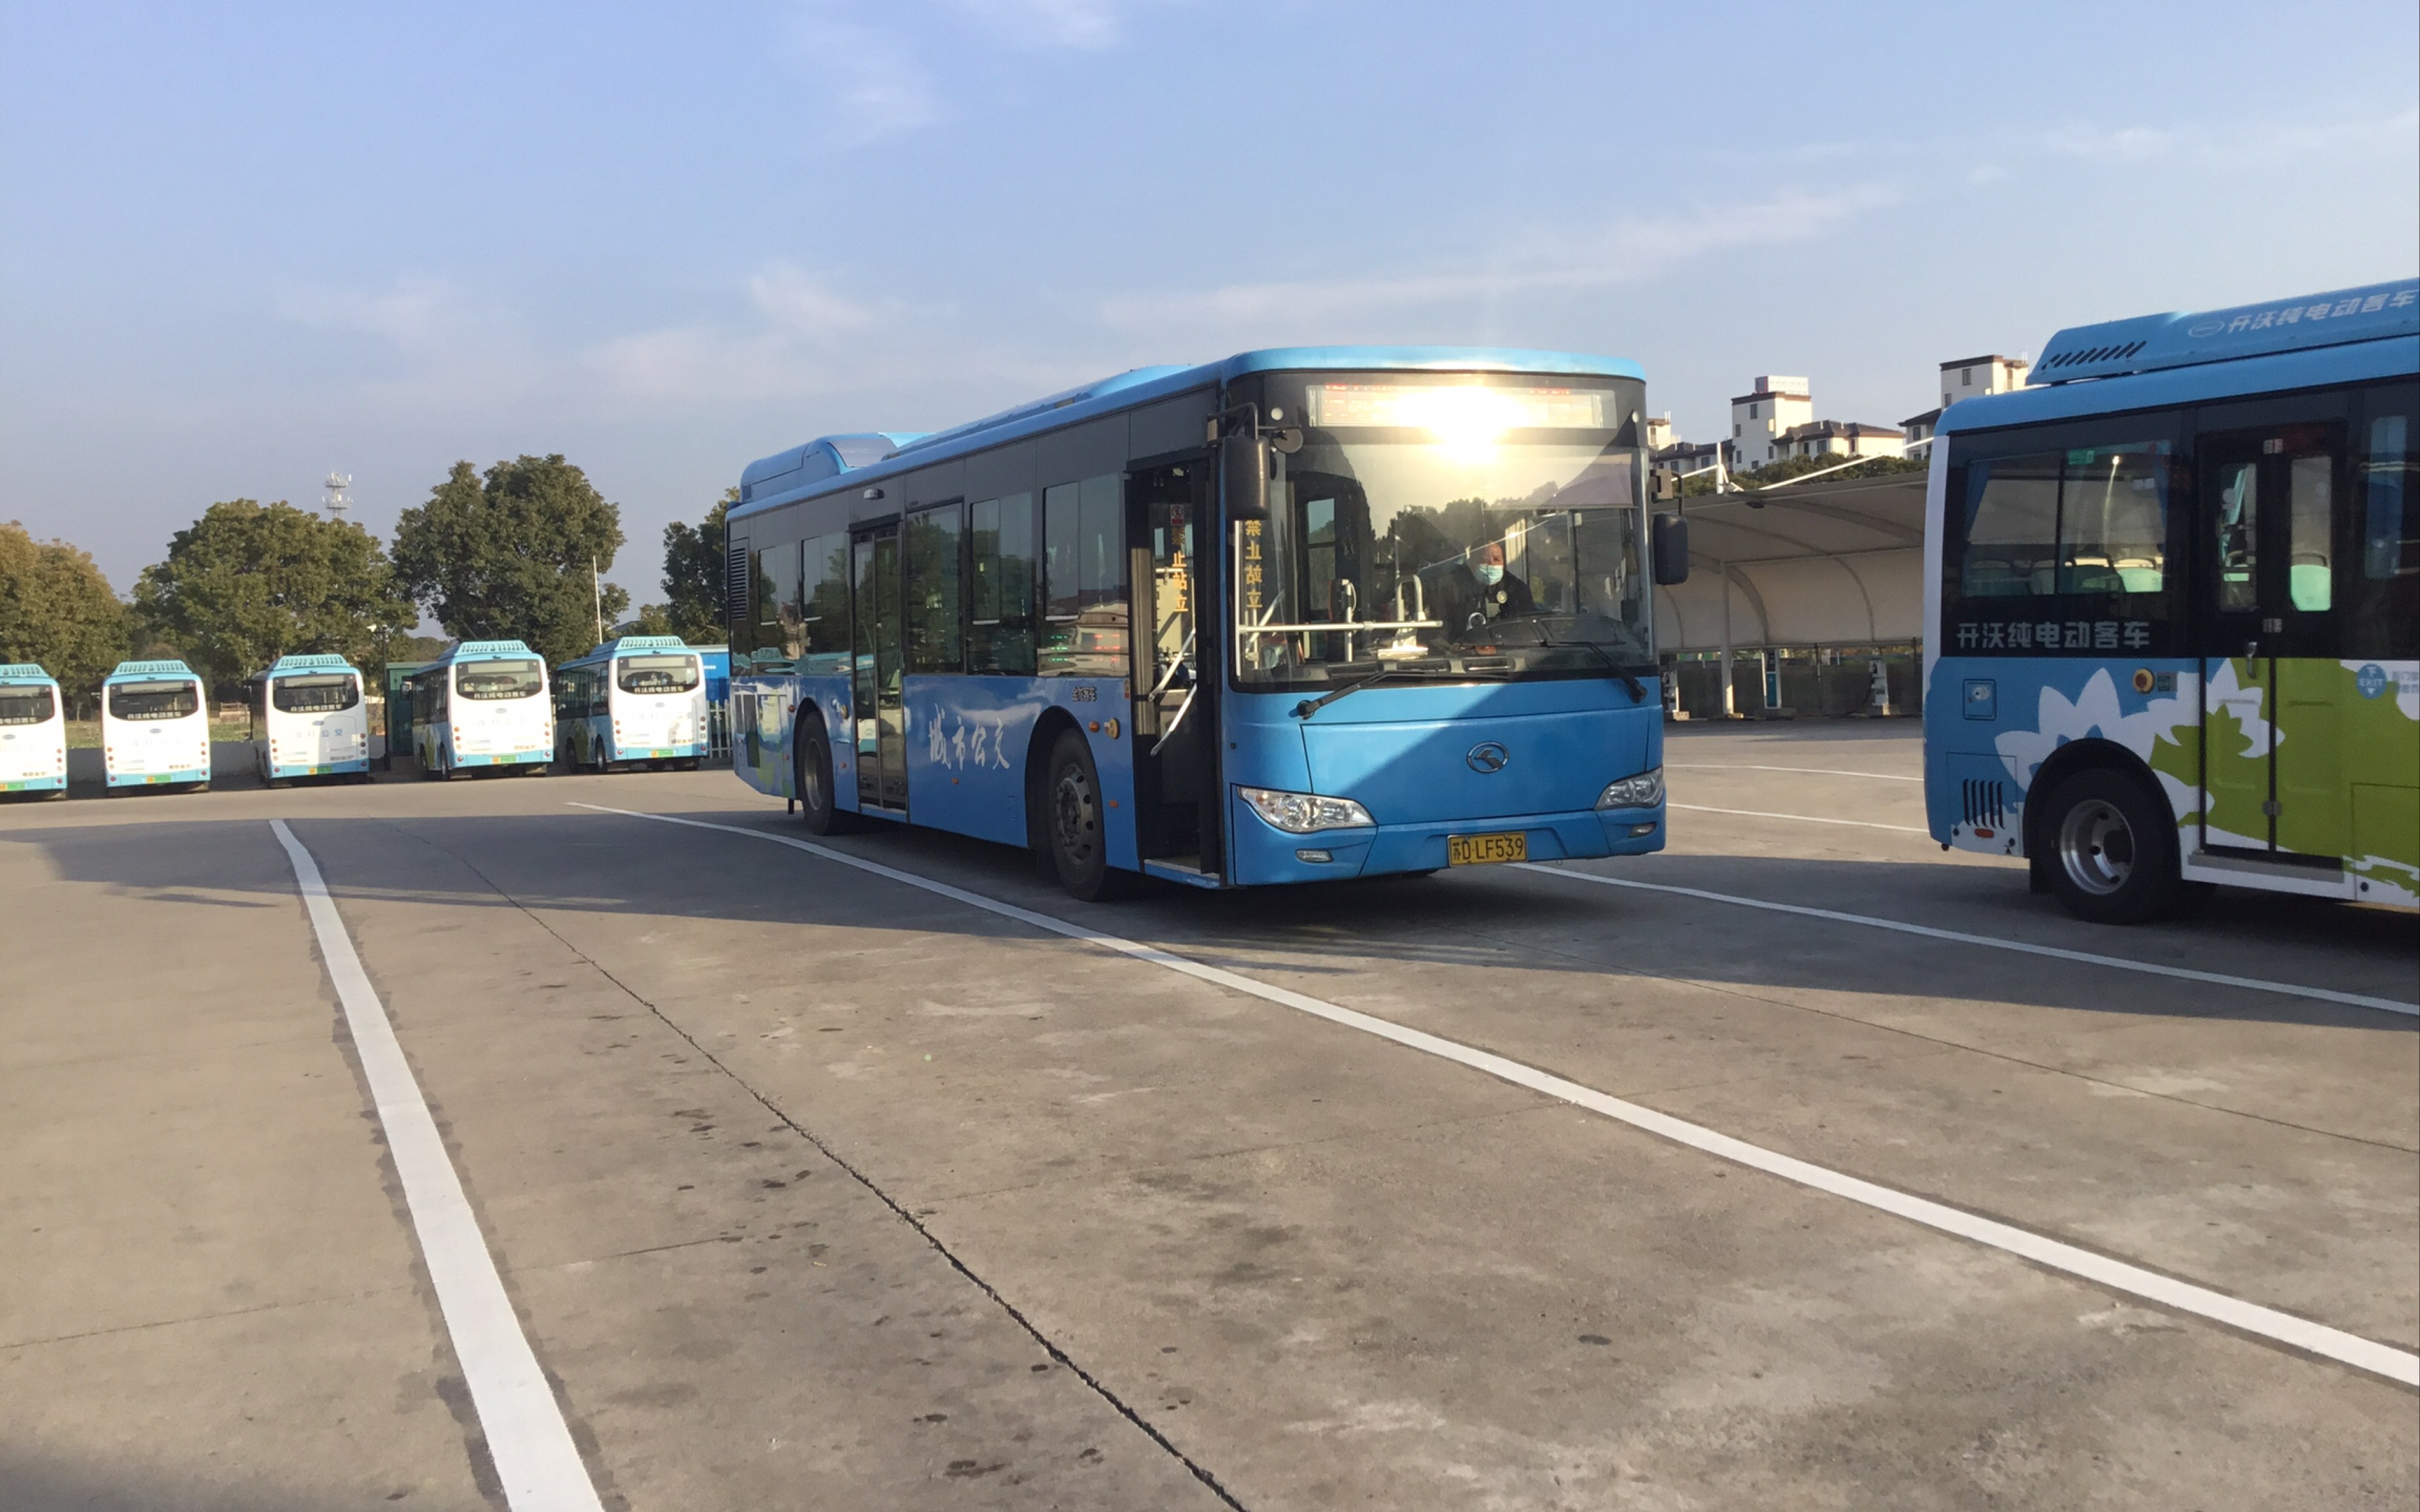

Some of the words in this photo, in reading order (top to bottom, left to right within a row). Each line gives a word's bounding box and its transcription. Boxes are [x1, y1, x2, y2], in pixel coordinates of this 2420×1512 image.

[2228, 289, 2419, 334] 开沃纯电动客车
[1957, 621, 2150, 649] 开沃纯电动客车
[2358, 678, 2384, 687] EXIT
[928, 702, 1010, 771] 城市公交
